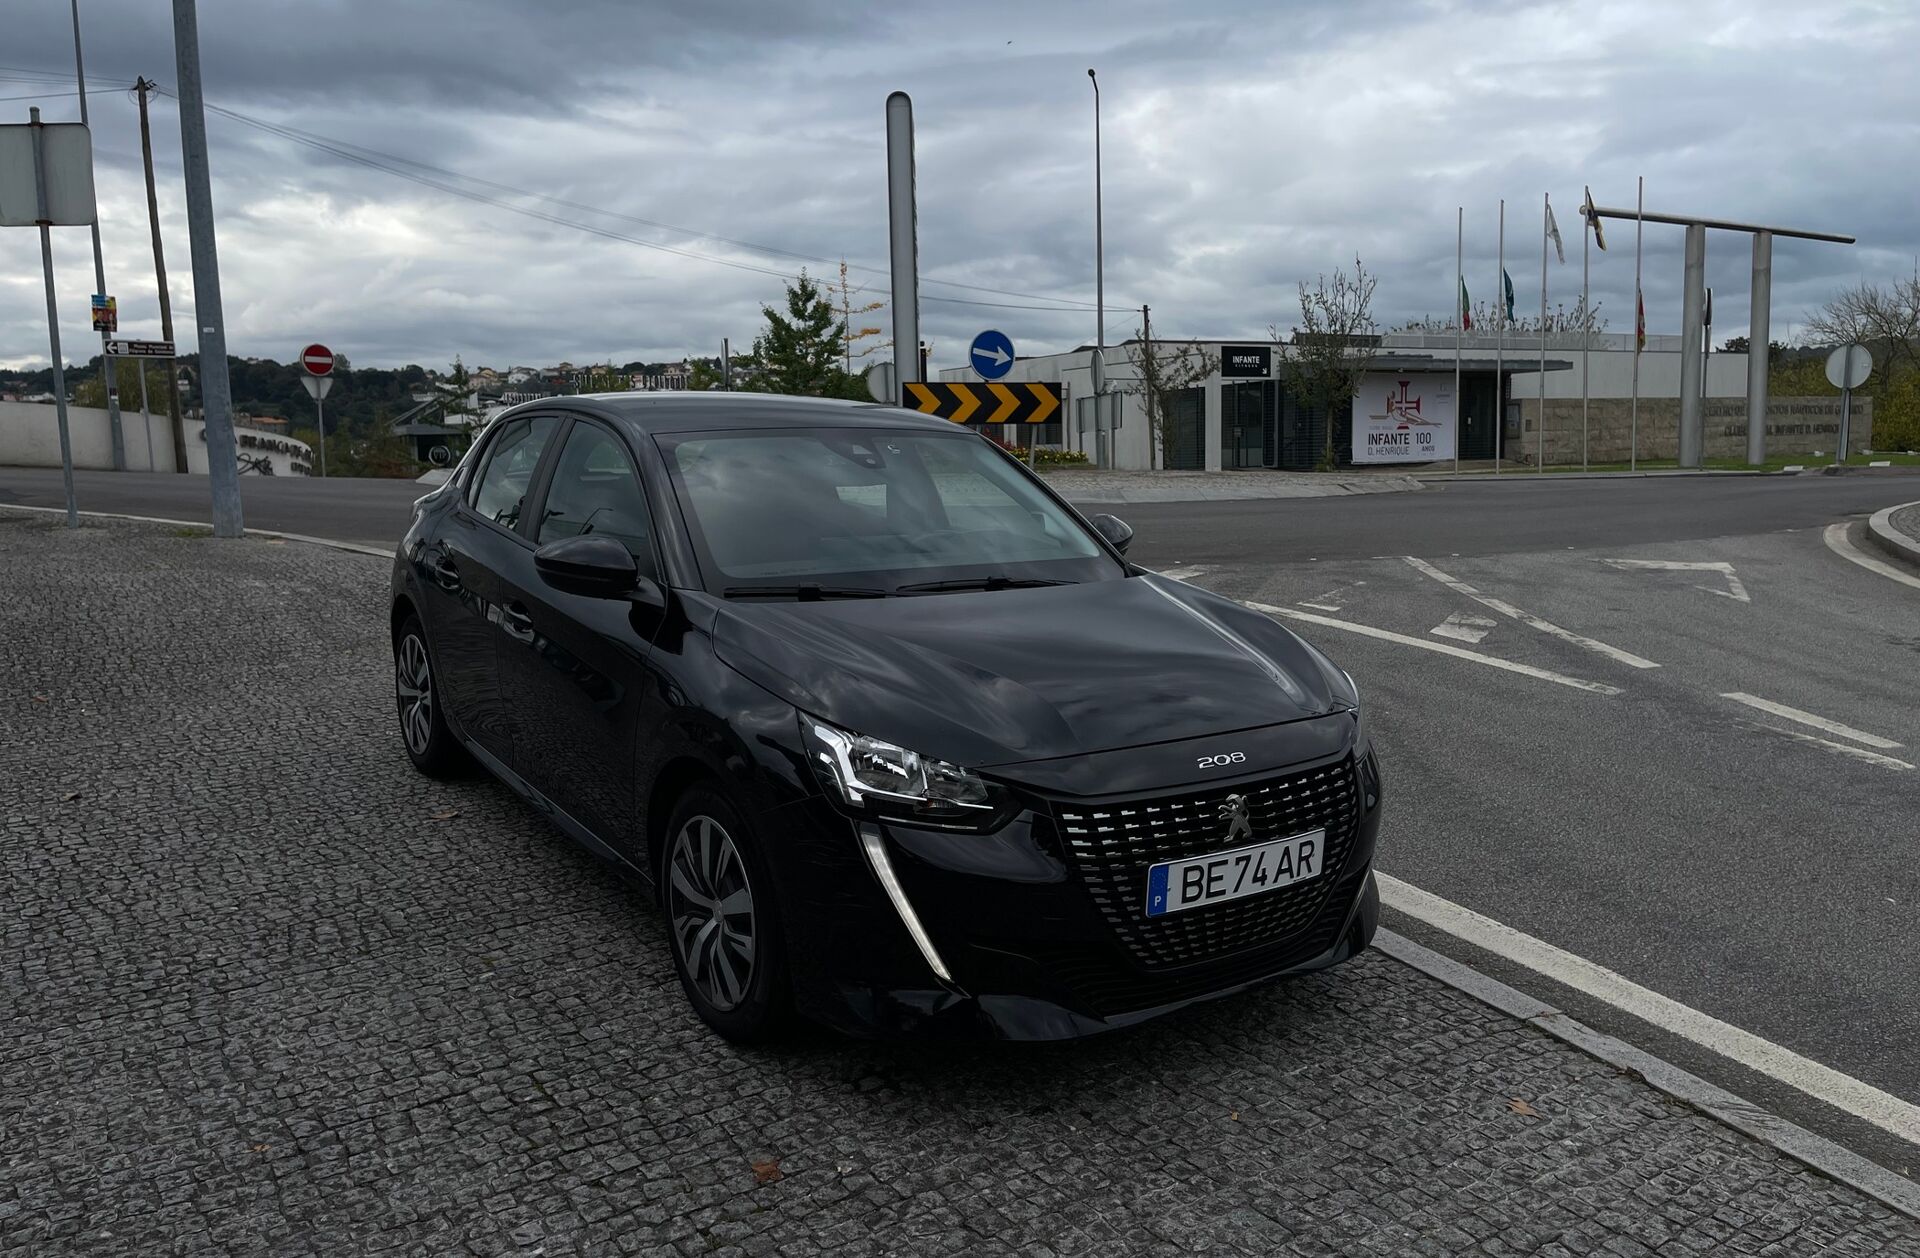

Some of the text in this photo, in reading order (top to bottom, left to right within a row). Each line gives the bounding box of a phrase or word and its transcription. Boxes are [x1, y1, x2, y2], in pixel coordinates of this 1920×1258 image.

[1232, 356, 1260, 364] INFANTE
[1368, 432, 1431, 445] INFANTE 100
[1367, 447, 1374, 456] D.
[1375, 446, 1410, 456] HENRIQUE
[1197, 751, 1246, 769] 208
[1153, 896, 1162, 907] P
